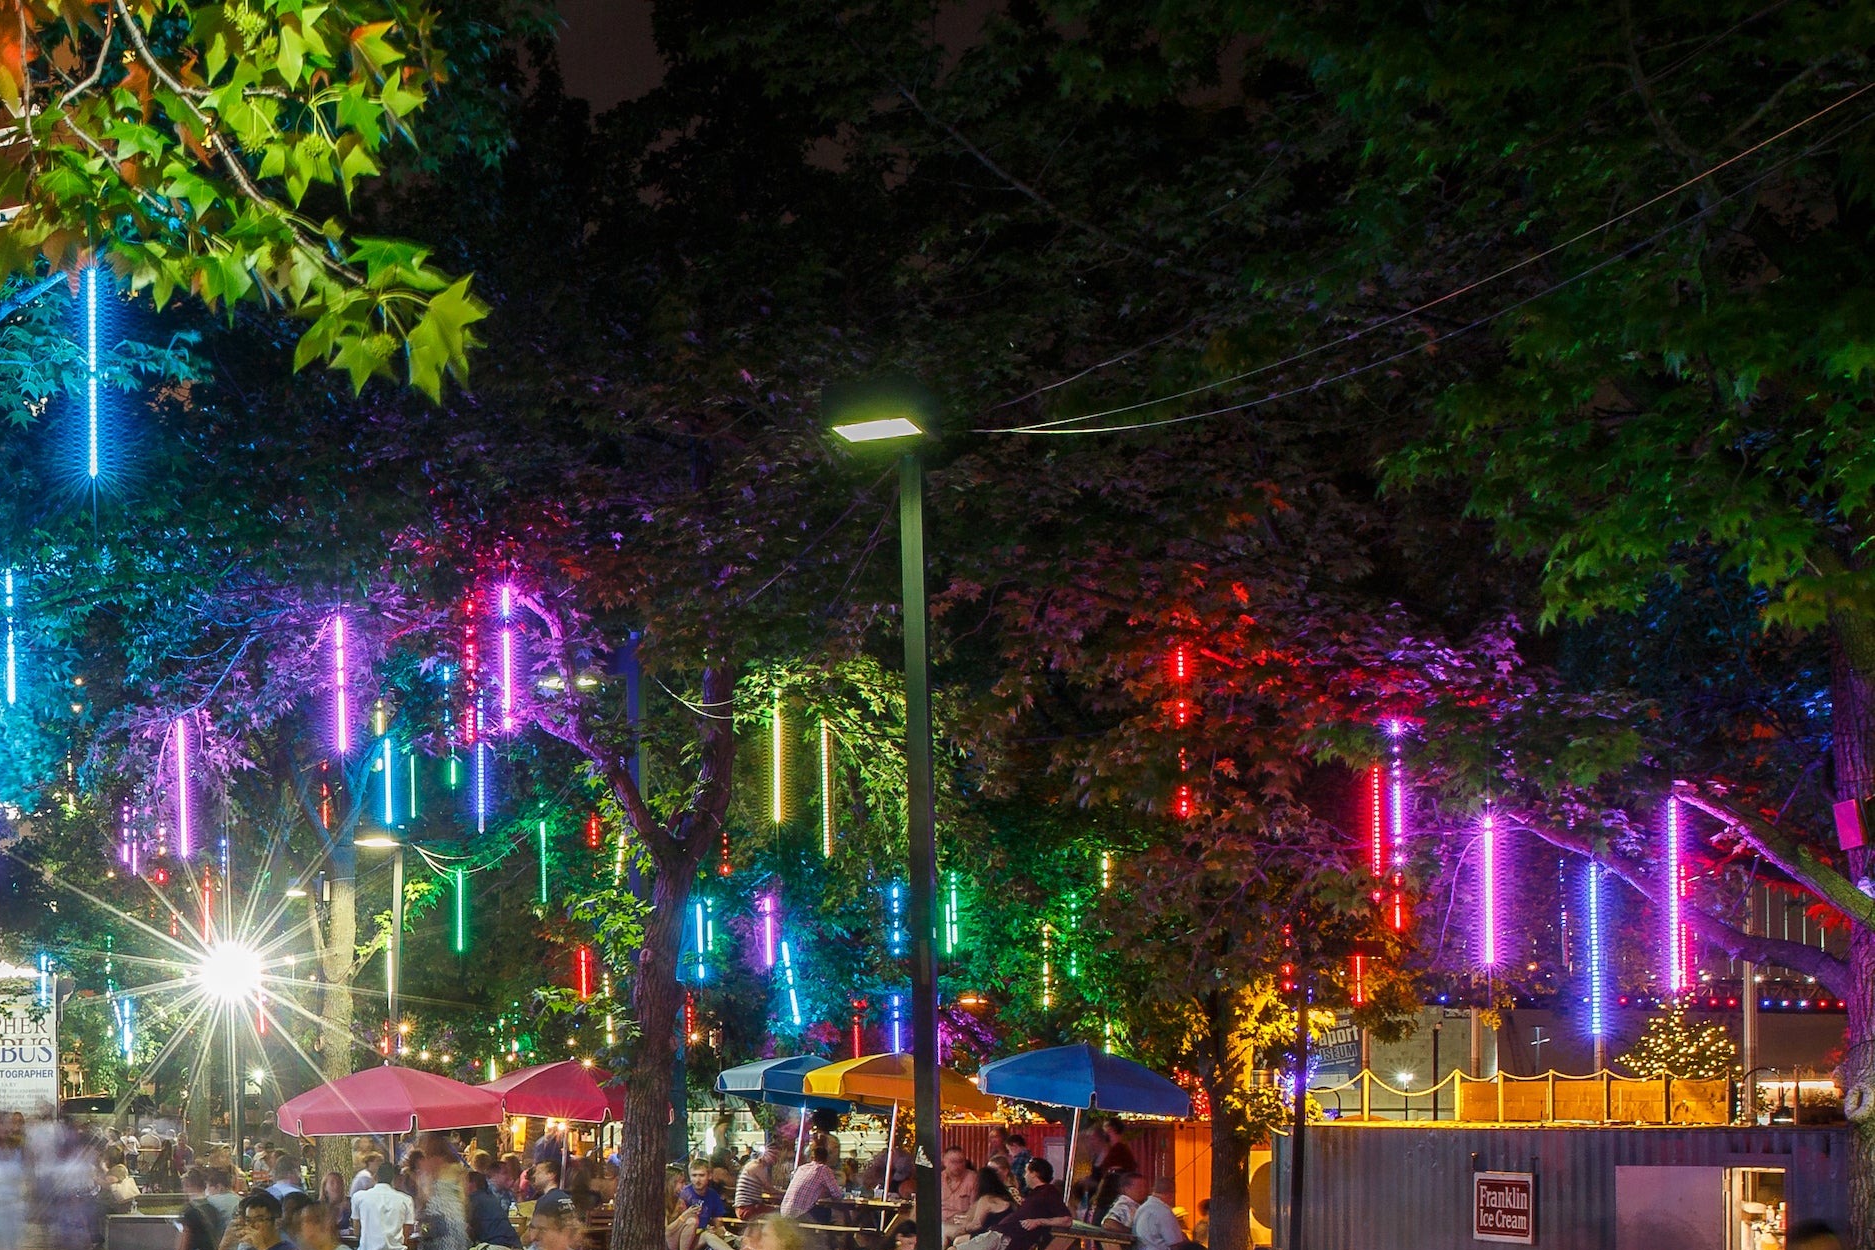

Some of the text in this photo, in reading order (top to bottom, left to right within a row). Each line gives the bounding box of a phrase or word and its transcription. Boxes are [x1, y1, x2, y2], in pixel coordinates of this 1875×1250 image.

[1479, 1185, 1528, 1210] Franklin
[1479, 1208, 1527, 1230] Ice Cream
